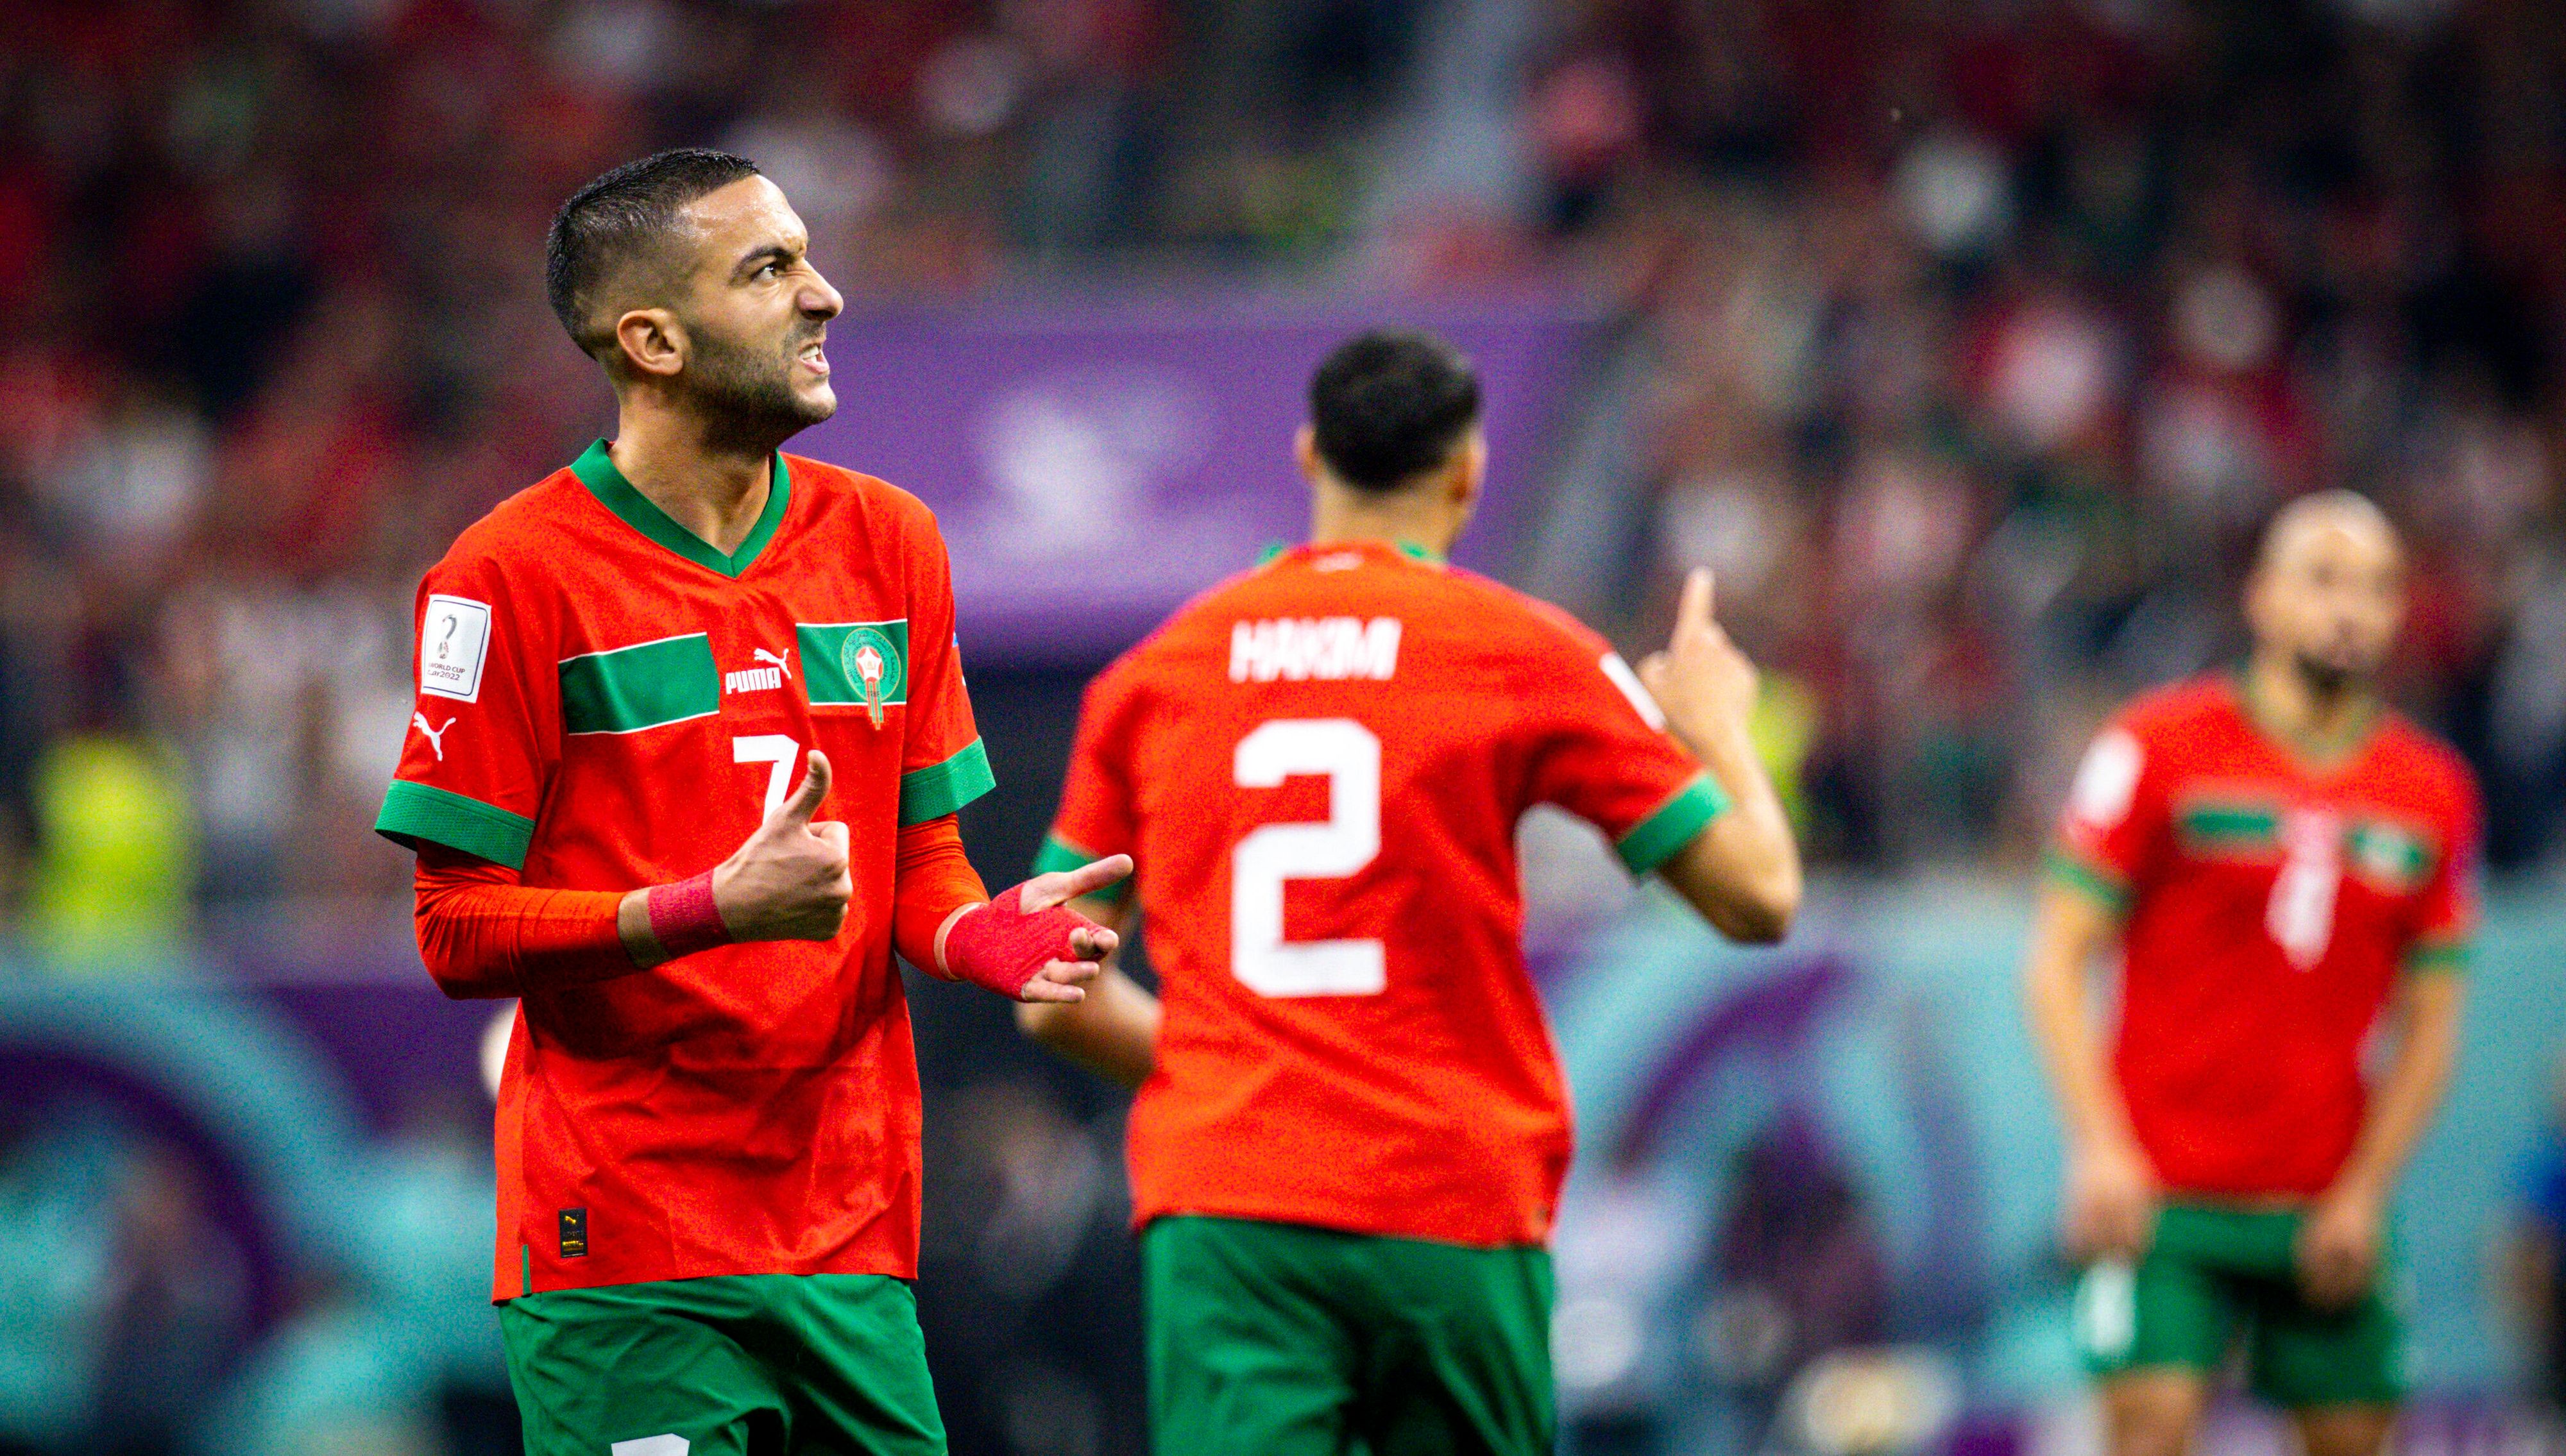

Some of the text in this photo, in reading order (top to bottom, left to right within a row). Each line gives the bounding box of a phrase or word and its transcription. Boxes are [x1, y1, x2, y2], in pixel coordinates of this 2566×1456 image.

[726, 667, 781, 695] PUMA
[1229, 616, 1402, 683] HAKIMI
[733, 734, 799, 825] 7
[1231, 718, 1387, 998] 2
